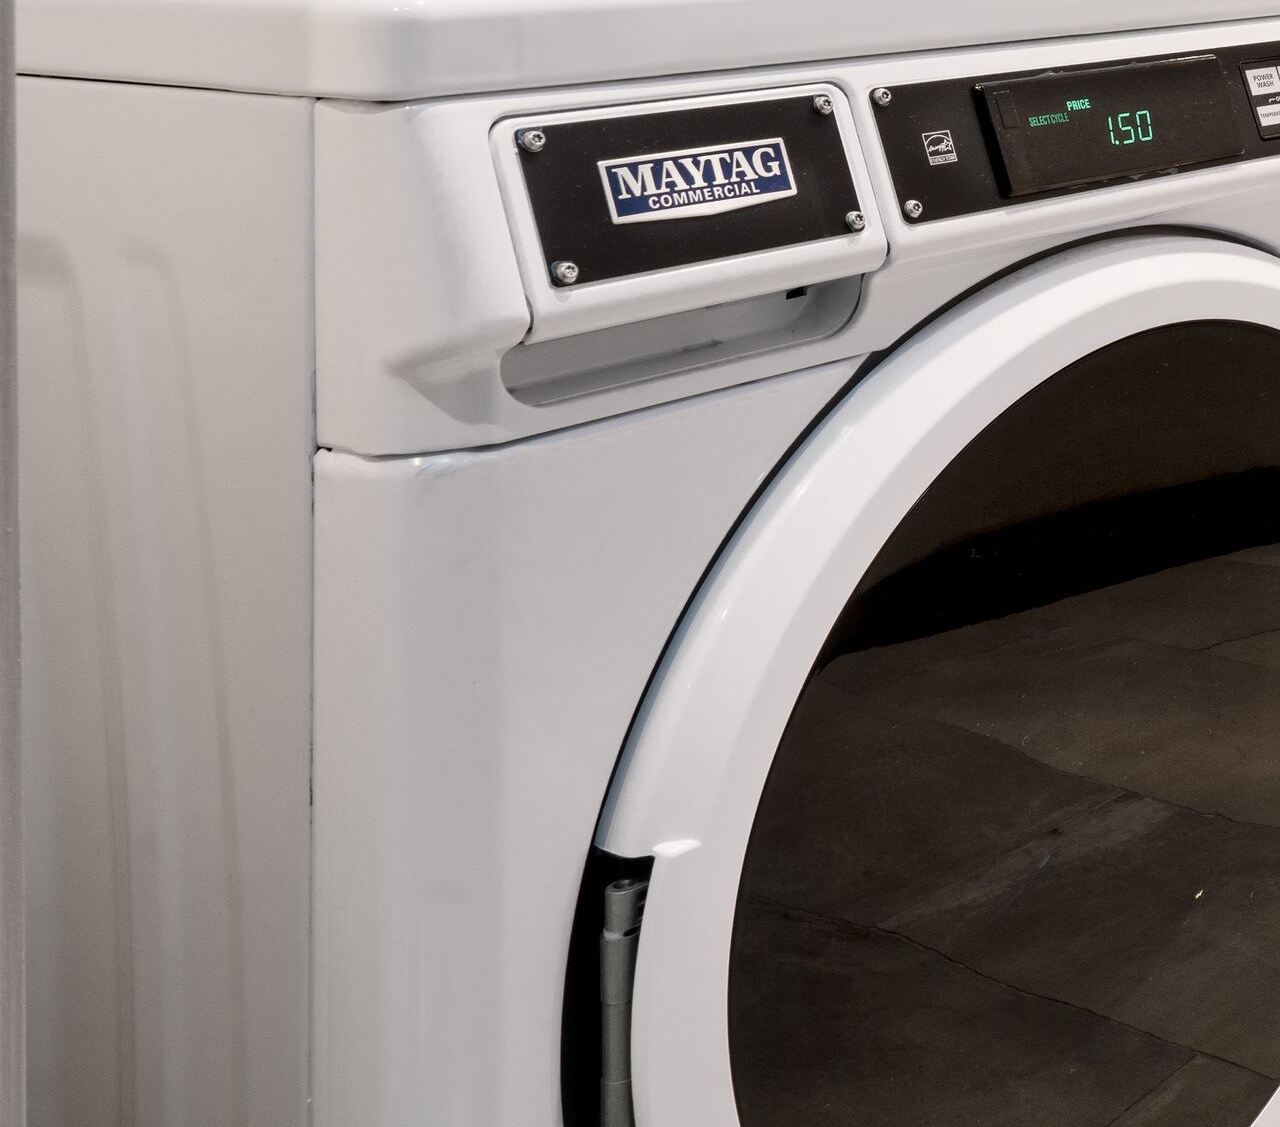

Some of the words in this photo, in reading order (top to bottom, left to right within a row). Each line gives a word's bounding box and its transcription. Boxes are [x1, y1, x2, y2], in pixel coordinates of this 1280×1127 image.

[1066, 98, 1091, 111] PRICE
[1028, 114, 1051, 127] SELECT
[1050, 112, 1070, 124] CYCLE
[1107, 109, 1153, 146] 1.50
[611, 147, 782, 200] MAYTAG
[648, 181, 761, 210] COMMERCIAL
